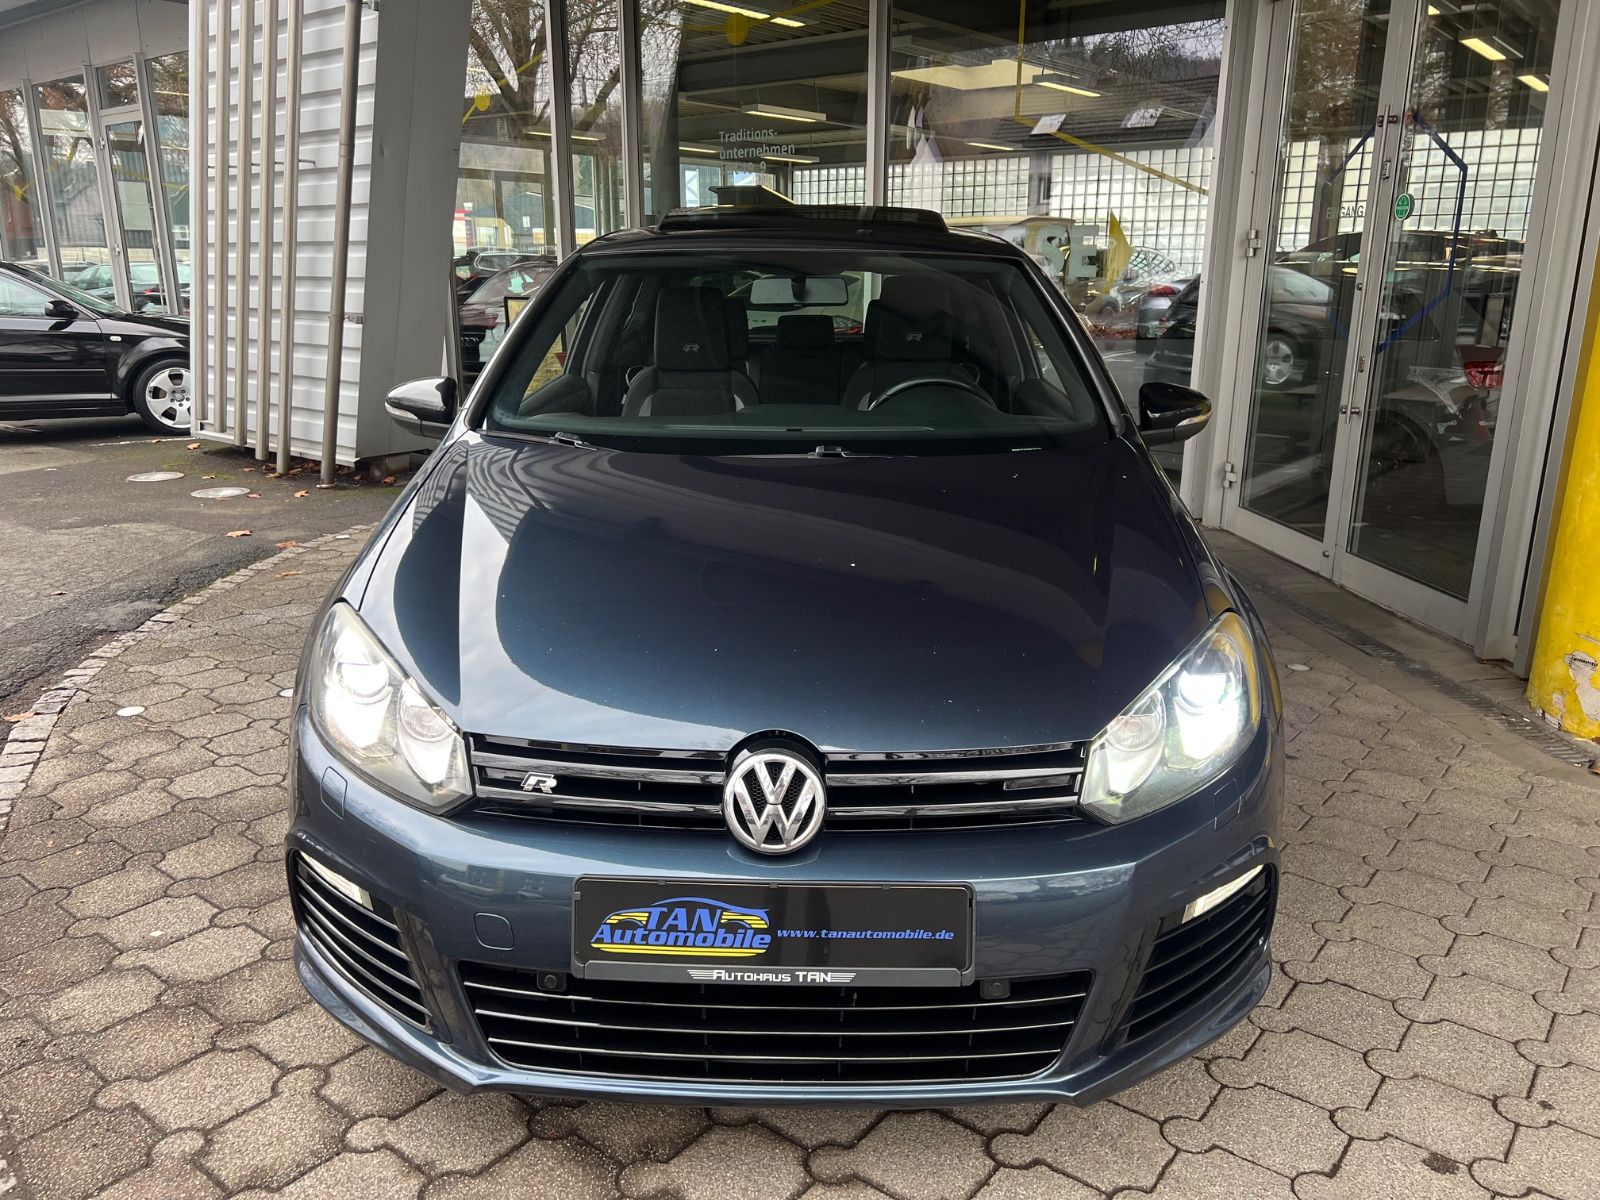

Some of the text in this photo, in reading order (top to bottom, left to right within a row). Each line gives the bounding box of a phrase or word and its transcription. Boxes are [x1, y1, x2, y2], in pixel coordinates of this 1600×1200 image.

[719, 128, 778, 143] Traditions-
[719, 144, 795, 160] unternehmen
[520, 771, 557, 794] R
[646, 907, 722, 931] TAN
[590, 923, 955, 949] Automobile www.tanautomobile.de
[713, 969, 832, 983] AUTOHAUS TAN
